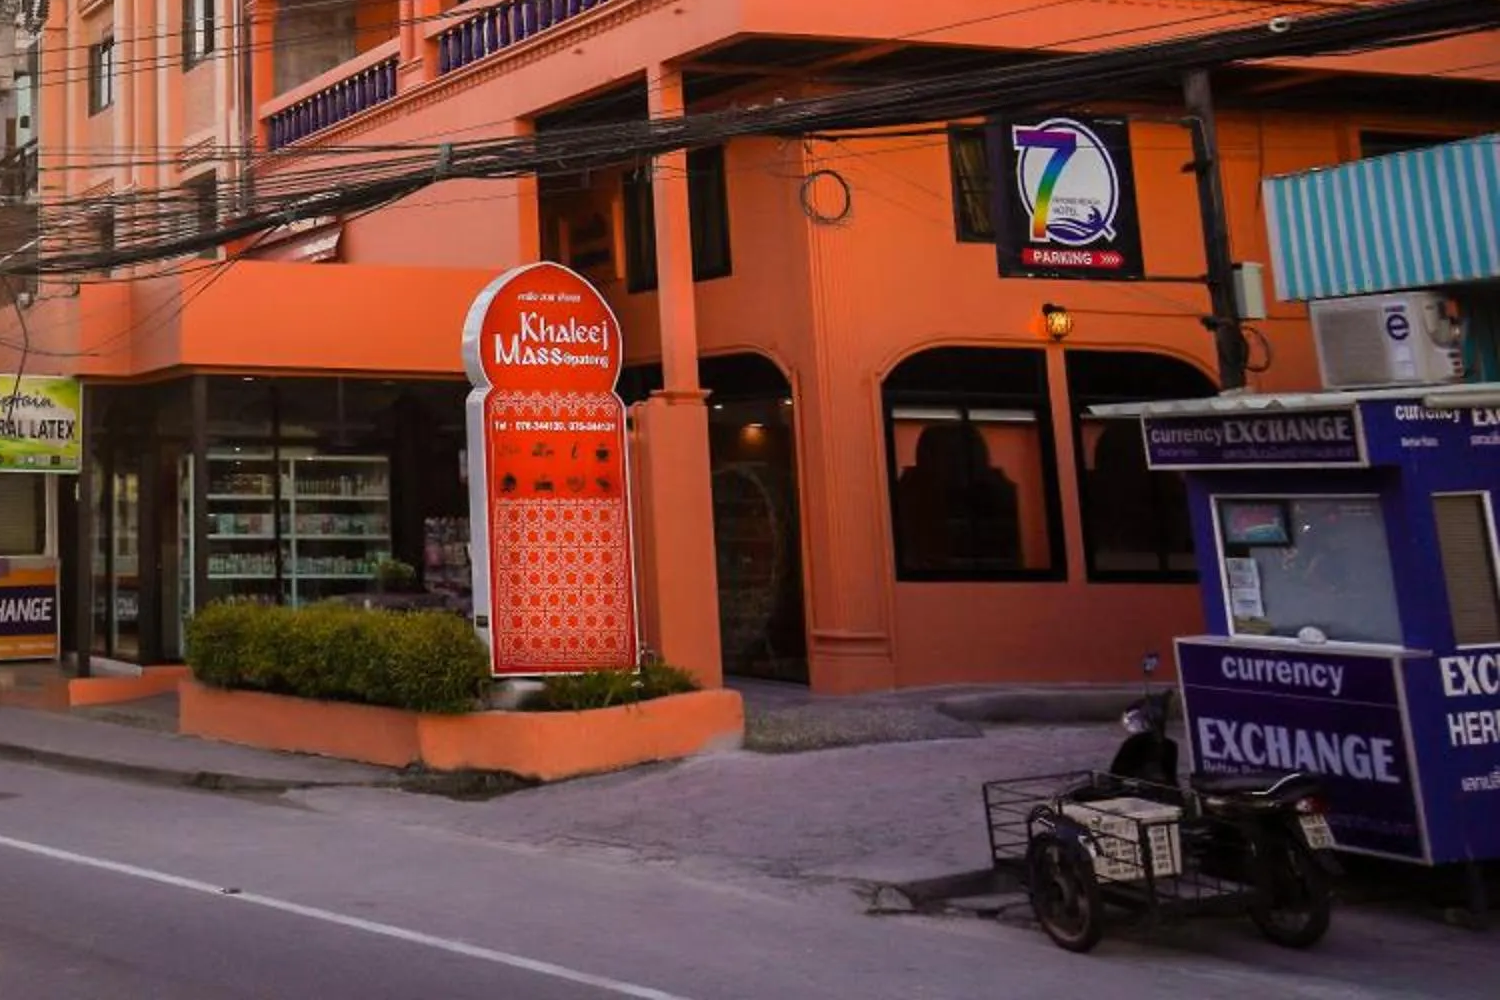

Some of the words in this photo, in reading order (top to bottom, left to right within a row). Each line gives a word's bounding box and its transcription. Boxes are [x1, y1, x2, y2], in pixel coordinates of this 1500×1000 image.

[1032, 249, 1093, 265] PARKING
[520, 311, 609, 351] Khaleej
[29, 419, 76, 440] LATEX
[1151, 426, 1224, 446] currency
[1224, 416, 1353, 443] EXCHANGE
[1471, 407, 1500, 427] EX
[1220, 655, 1345, 697] currency
[1438, 653, 1500, 697] EXC
[1196, 716, 1401, 783] EXCHANGE
